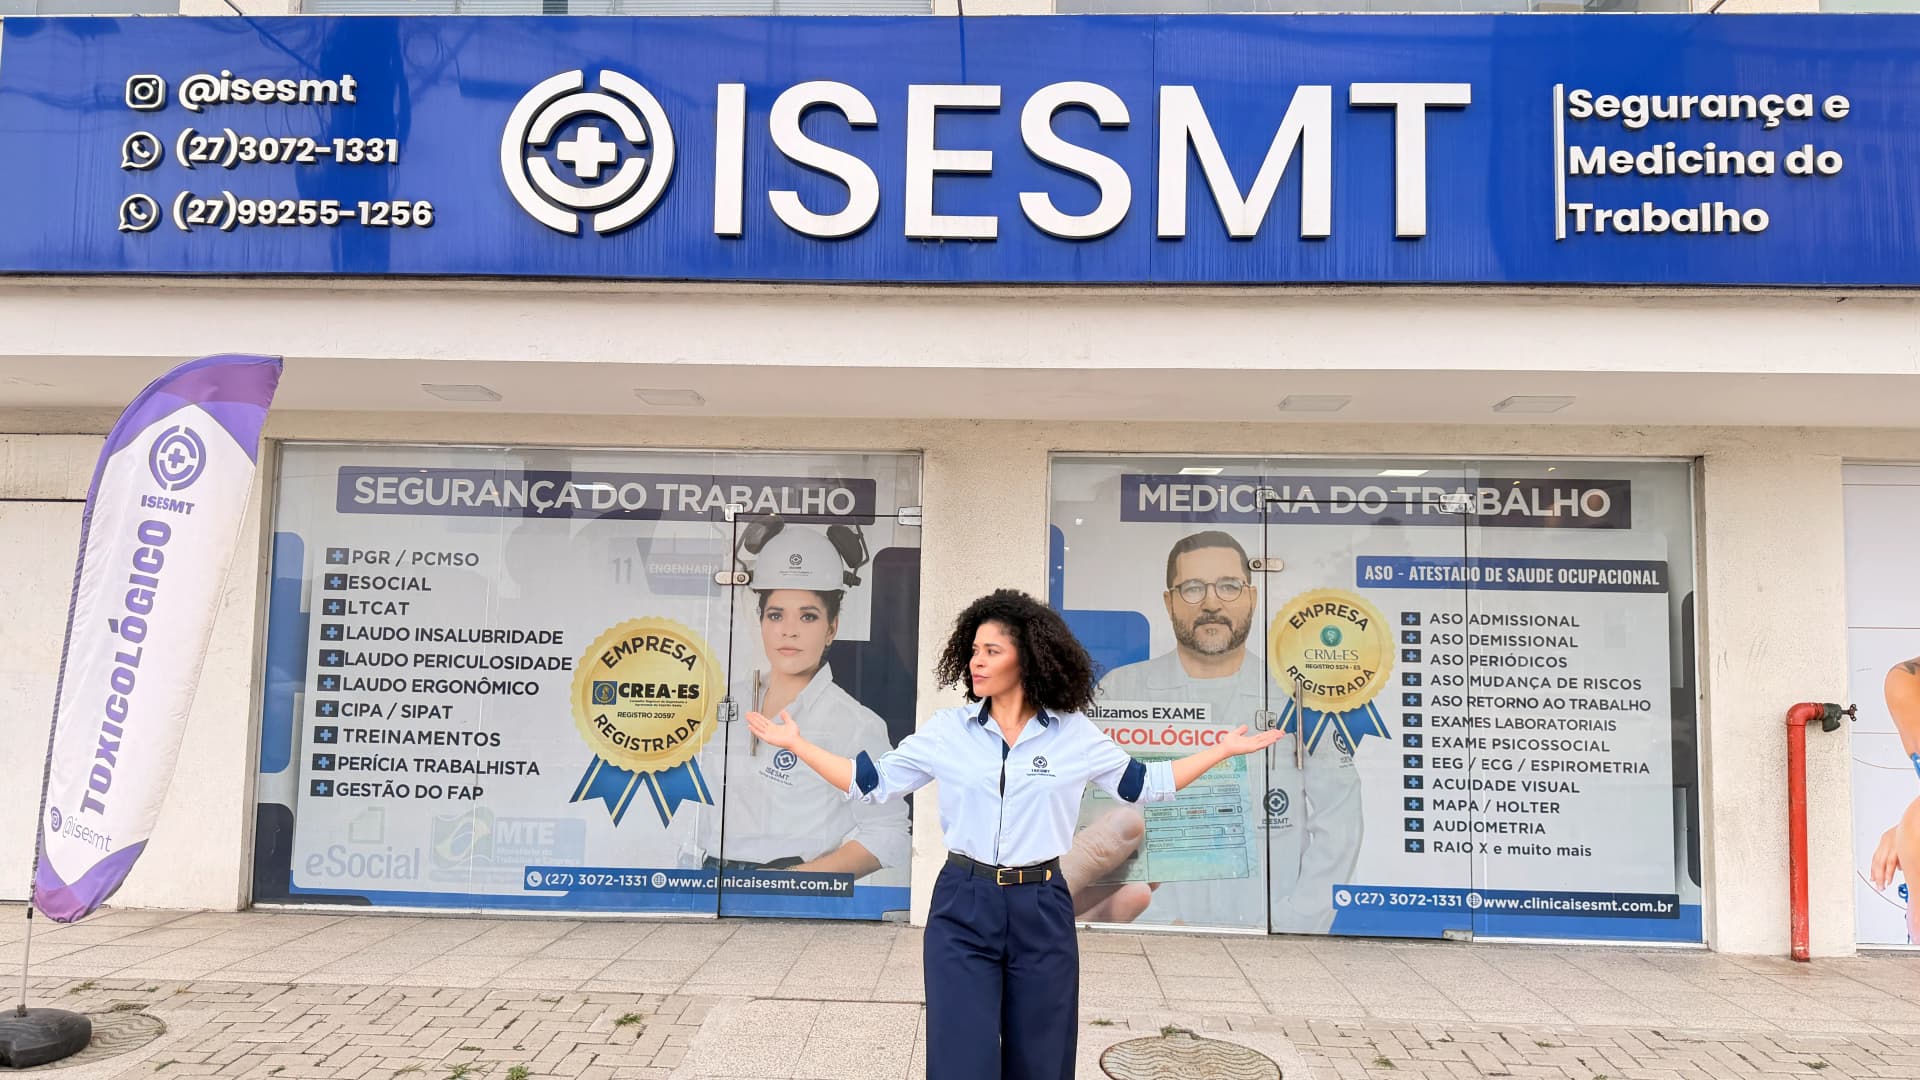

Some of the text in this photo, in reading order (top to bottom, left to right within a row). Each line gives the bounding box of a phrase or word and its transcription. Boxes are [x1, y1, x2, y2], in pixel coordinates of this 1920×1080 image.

[179, 70, 357, 112] @isesmt
[1568, 88, 1850, 129] Segurança e
[176, 128, 399, 168] (27)3072-1331
[714, 81, 1471, 240] ISESMT
[1568, 141, 1843, 176] Medicina do
[172, 190, 434, 231] (27)99255-1256
[1568, 201, 1770, 234] Trabalho
[141, 494, 195, 515] ISESMT
[354, 476, 856, 515] SEGURANÇA DO TRABALHO
[1138, 483, 1611, 518] MEDICNA DO TRBALHO
[352, 549, 479, 567] PGR / PCMSO
[348, 576, 432, 592] ESOCIAL
[1365, 565, 1393, 581] ASO
[1409, 566, 1480, 582] ATESTADO
[1485, 567, 1502, 582] DE
[1507, 568, 1554, 584] SAUDE
[1558, 568, 1660, 585] OCUPACIONAL
[348, 601, 410, 616] LTCAT
[1289, 603, 1368, 631] EMPRESA
[1430, 613, 1580, 628] ASO ADMISSIONAL
[346, 626, 564, 645] LAUDO INSALUBRIDADE
[1430, 633, 1579, 648] ASO DEMISSIONAL
[345, 652, 573, 671] LAUDO PERICULOSIDADE
[601, 636, 697, 671] EMPRESA
[1304, 649, 1359, 661] CRM-ES
[1430, 652, 1568, 669] ASO PERIÓDICOS
[80, 519, 172, 816] TOXICOLÓGICO
[343, 676, 540, 696] LAUDO ERGONÔMICO
[618, 683, 700, 700] CREA-ES
[1430, 674, 1642, 691] ASO MUDANÇA DE RISCOS
[341, 703, 453, 720] CIPA / SIPAT
[1087, 706, 1206, 720] alizamos EXAME
[1431, 695, 1651, 712] ASO RETORNO AO TRABALHO
[617, 711, 652, 719] REGISTRO
[1431, 716, 1616, 732] EXAMES LABORATORIAIS
[343, 728, 501, 747] TREINAMENTOS
[594, 714, 701, 752] REGISTRADA
[1103, 725, 1229, 747] ICOLÓGIC
[1432, 736, 1610, 753] EXAME PSICOSSOCIAL
[338, 753, 540, 776] PERÍCIA TRABALHISTA
[1432, 757, 1463, 770] EEG
[1481, 759, 1513, 771] ECG
[1517, 758, 1526, 773] /
[1531, 760, 1650, 774] ESPIROMETRIA
[337, 780, 484, 801] GESTÃO DO FAP
[1432, 778, 1580, 793] ACUIDADE VISUAL
[1433, 800, 1560, 814] MAPA / HOLTER
[63, 815, 112, 852] @isesmt
[497, 822, 555, 846] MTE
[1433, 821, 1546, 835] AUDIOMETRIA
[1433, 841, 1592, 857] RAIO X e muito mais
[306, 845, 421, 881] eSocial
[545, 873, 574, 886] (27)
[578, 873, 648, 887] 3072-1331
[1354, 892, 1674, 913] (27) 3072-1331 www.clinicaisesmt.com.br
